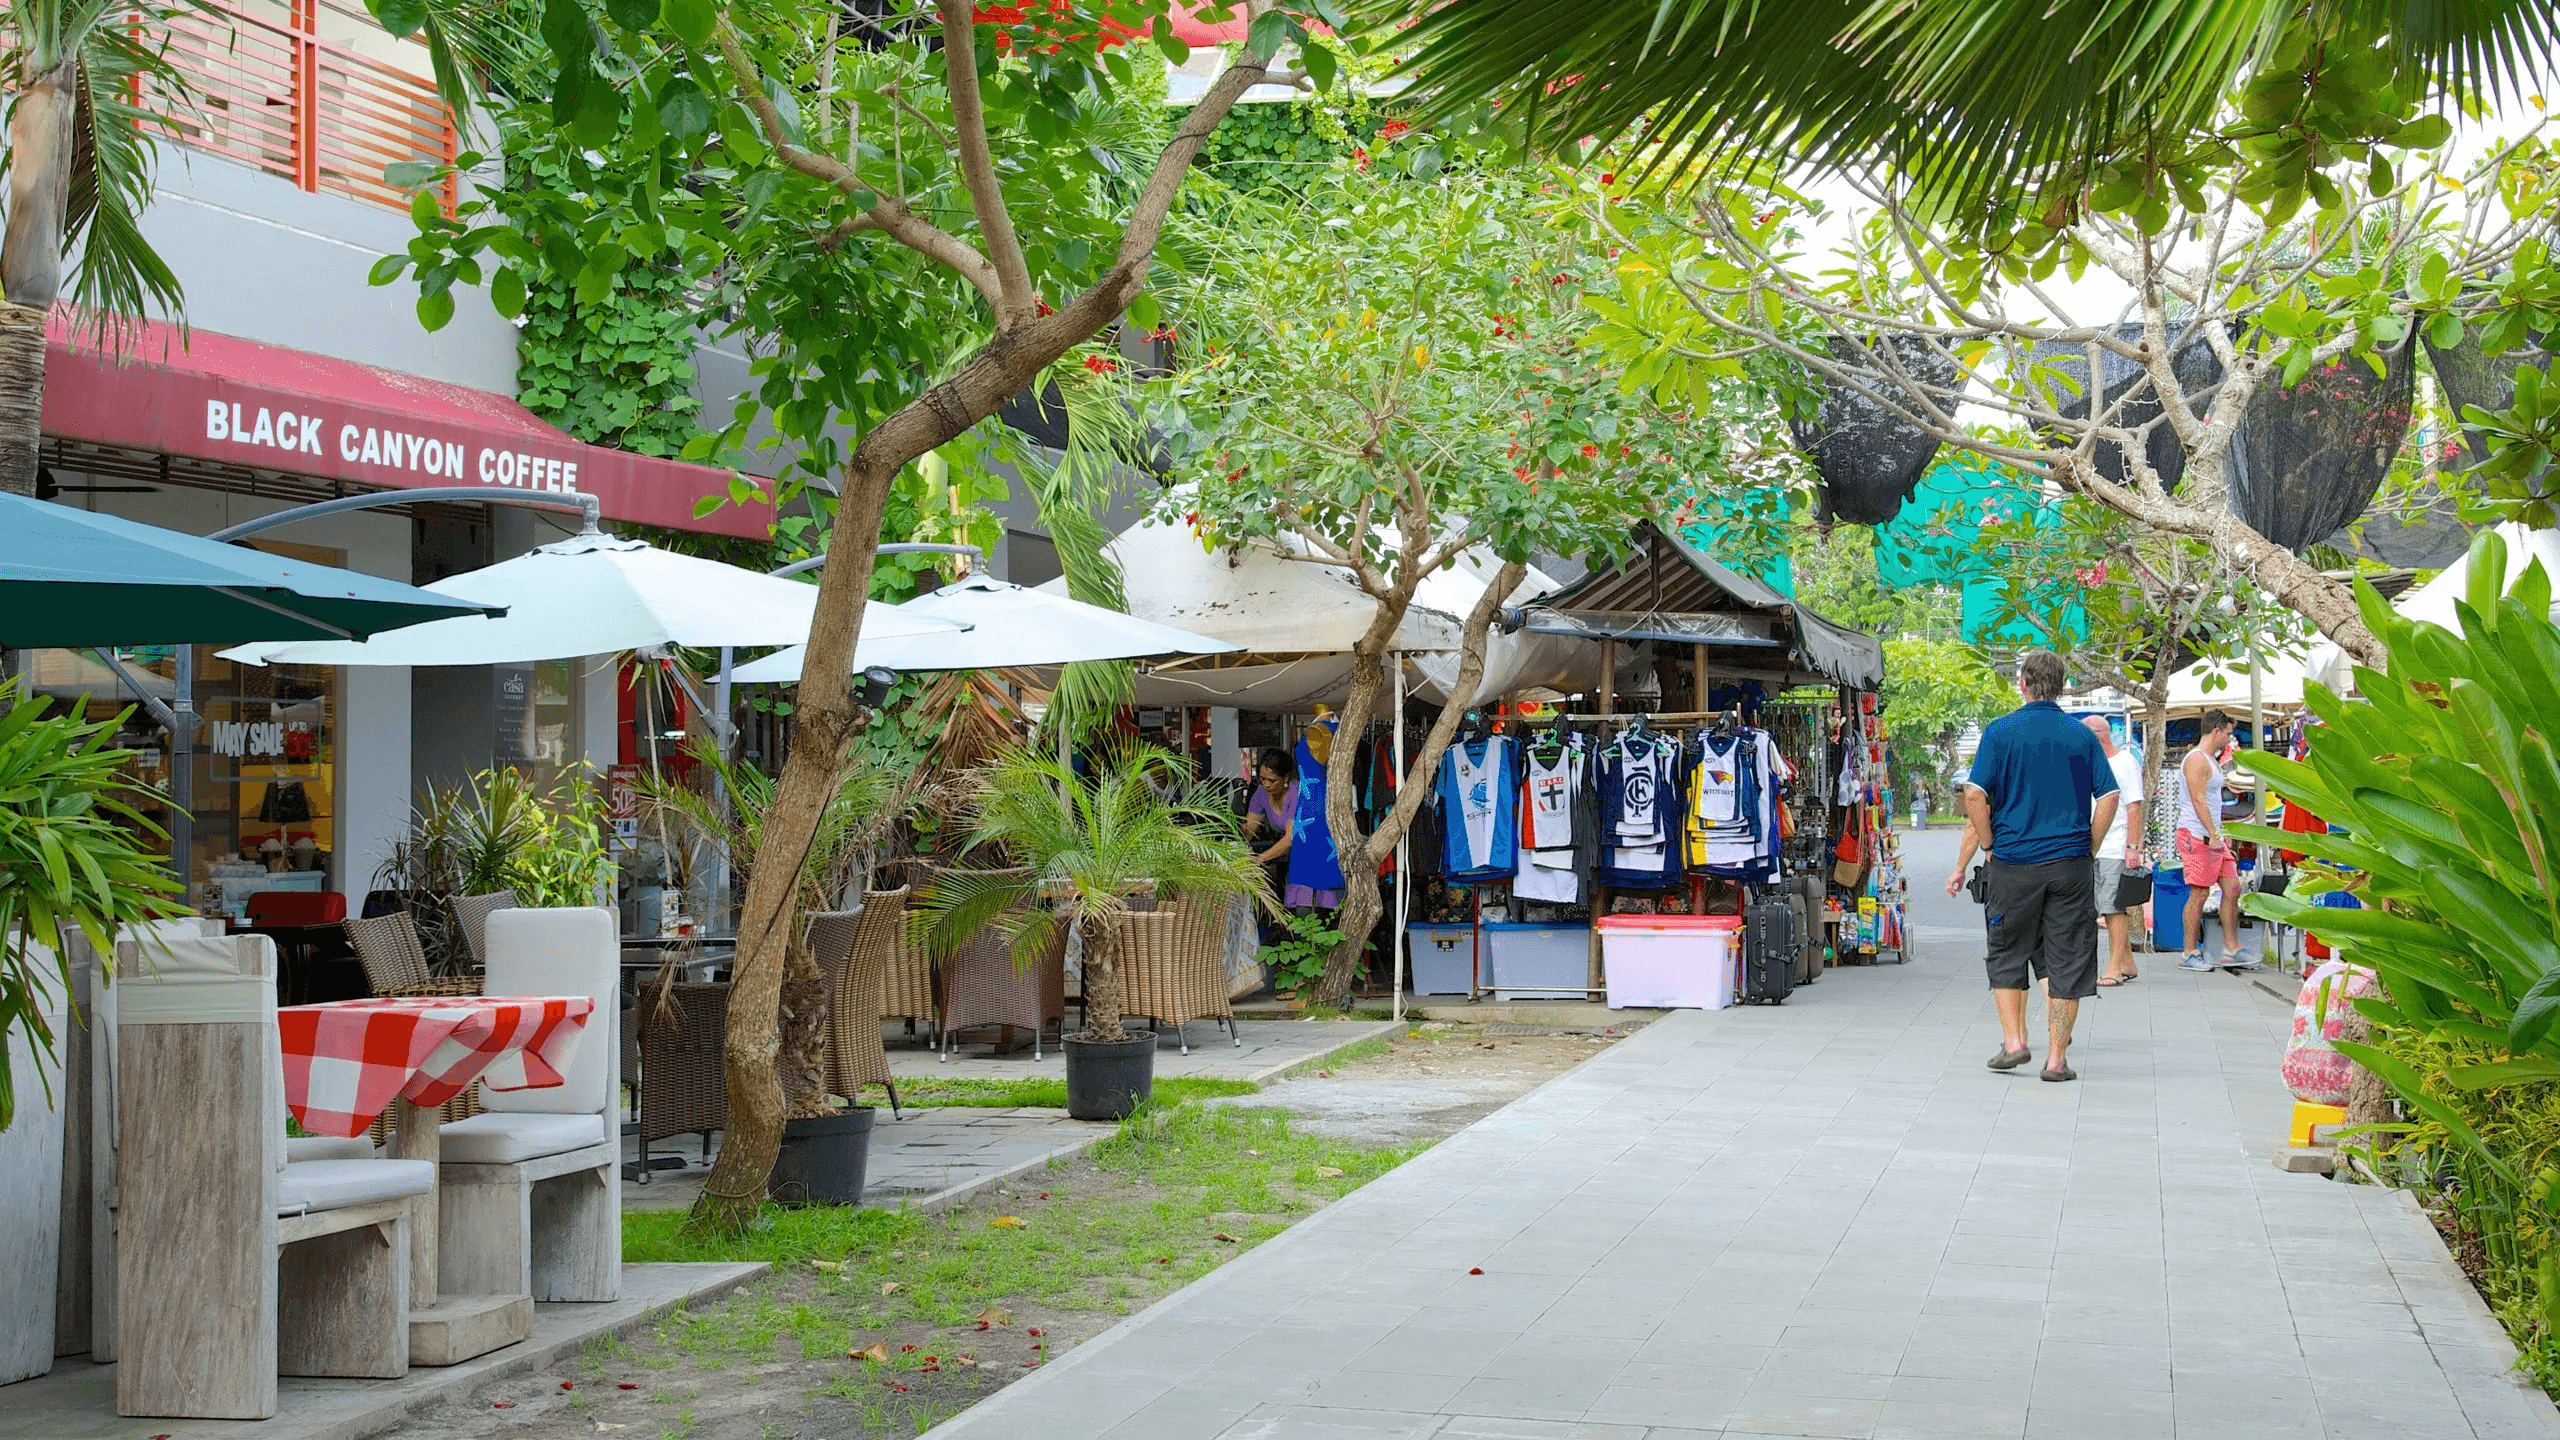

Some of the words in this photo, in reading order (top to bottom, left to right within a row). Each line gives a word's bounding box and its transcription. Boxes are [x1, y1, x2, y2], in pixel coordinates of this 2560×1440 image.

[206, 399, 324, 456] BLACK
[339, 424, 465, 480] CANYON
[478, 447, 578, 494] COFFEE
[213, 720, 250, 757] MAY
[249, 721, 284, 756] SALE
